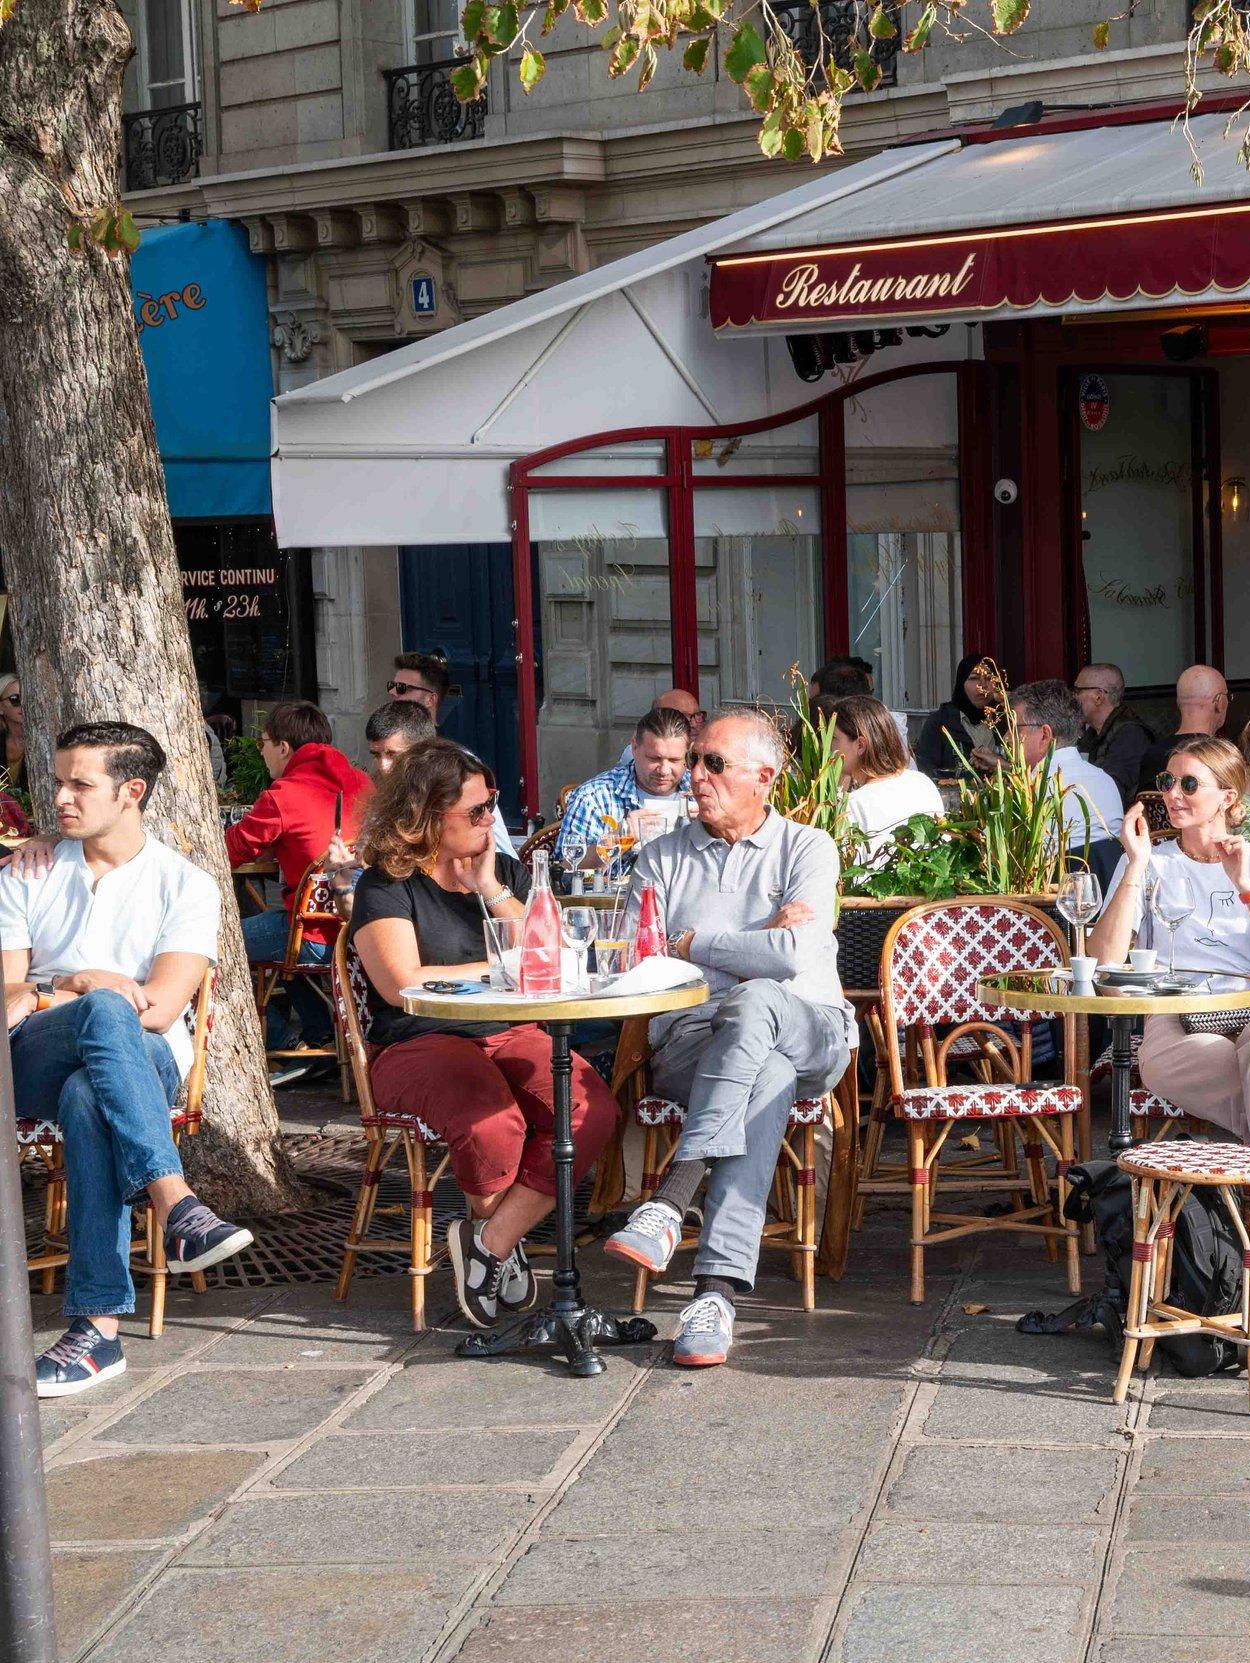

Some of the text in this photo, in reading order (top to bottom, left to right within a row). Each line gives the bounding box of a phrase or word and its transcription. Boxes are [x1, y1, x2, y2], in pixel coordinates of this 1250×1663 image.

[418, 281, 430, 309] 4
[776, 252, 977, 309] Restaurant
[134, 283, 208, 333] ère
[220, 568, 275, 585] CONTINU
